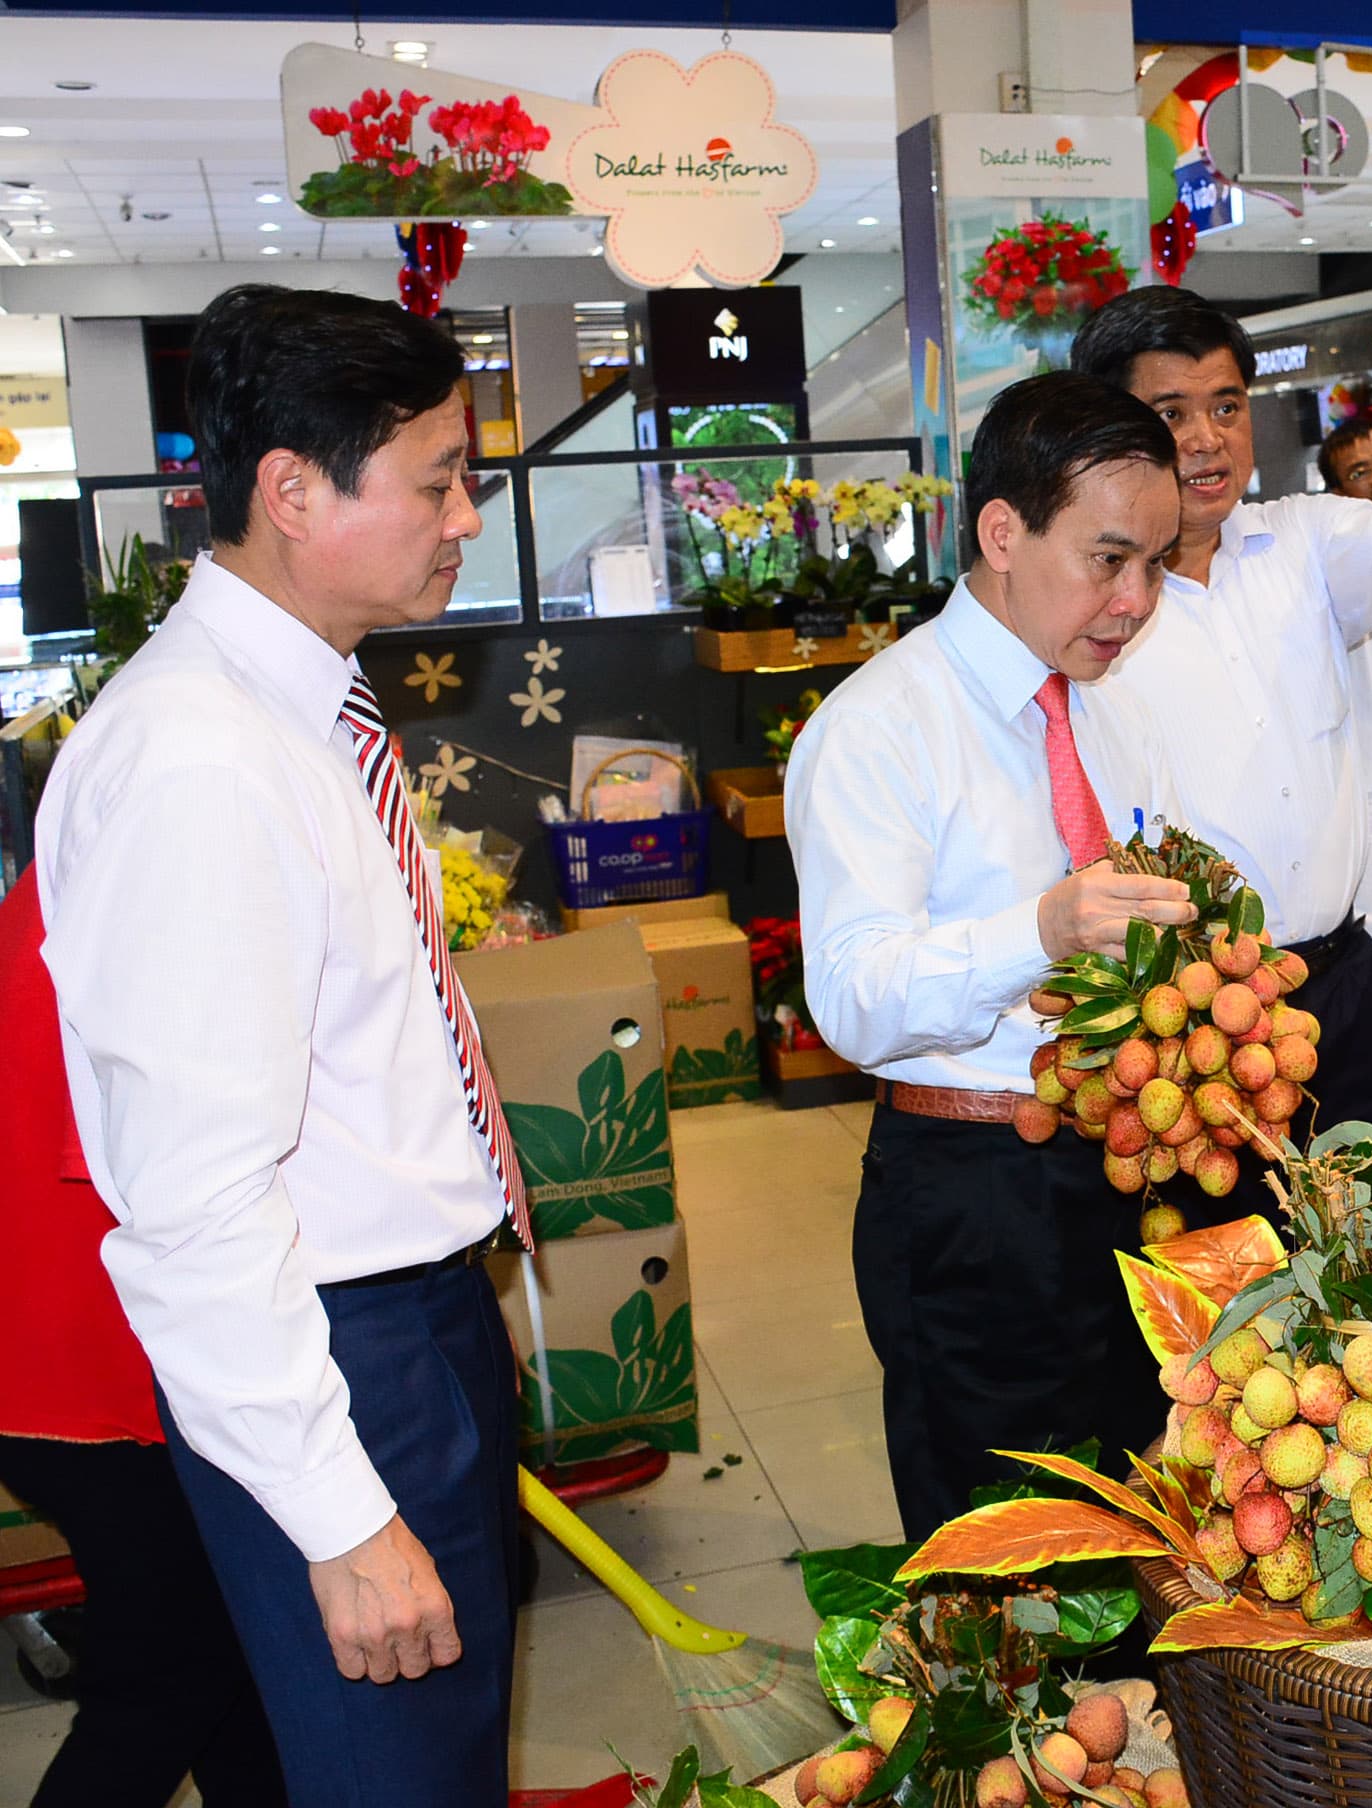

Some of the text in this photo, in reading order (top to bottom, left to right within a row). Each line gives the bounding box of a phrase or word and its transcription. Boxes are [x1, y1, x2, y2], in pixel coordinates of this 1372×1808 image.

[594, 152, 788, 183] Dalat Hasfarm
[979, 147, 1028, 167] Dalat
[708, 335, 749, 363] PNJ
